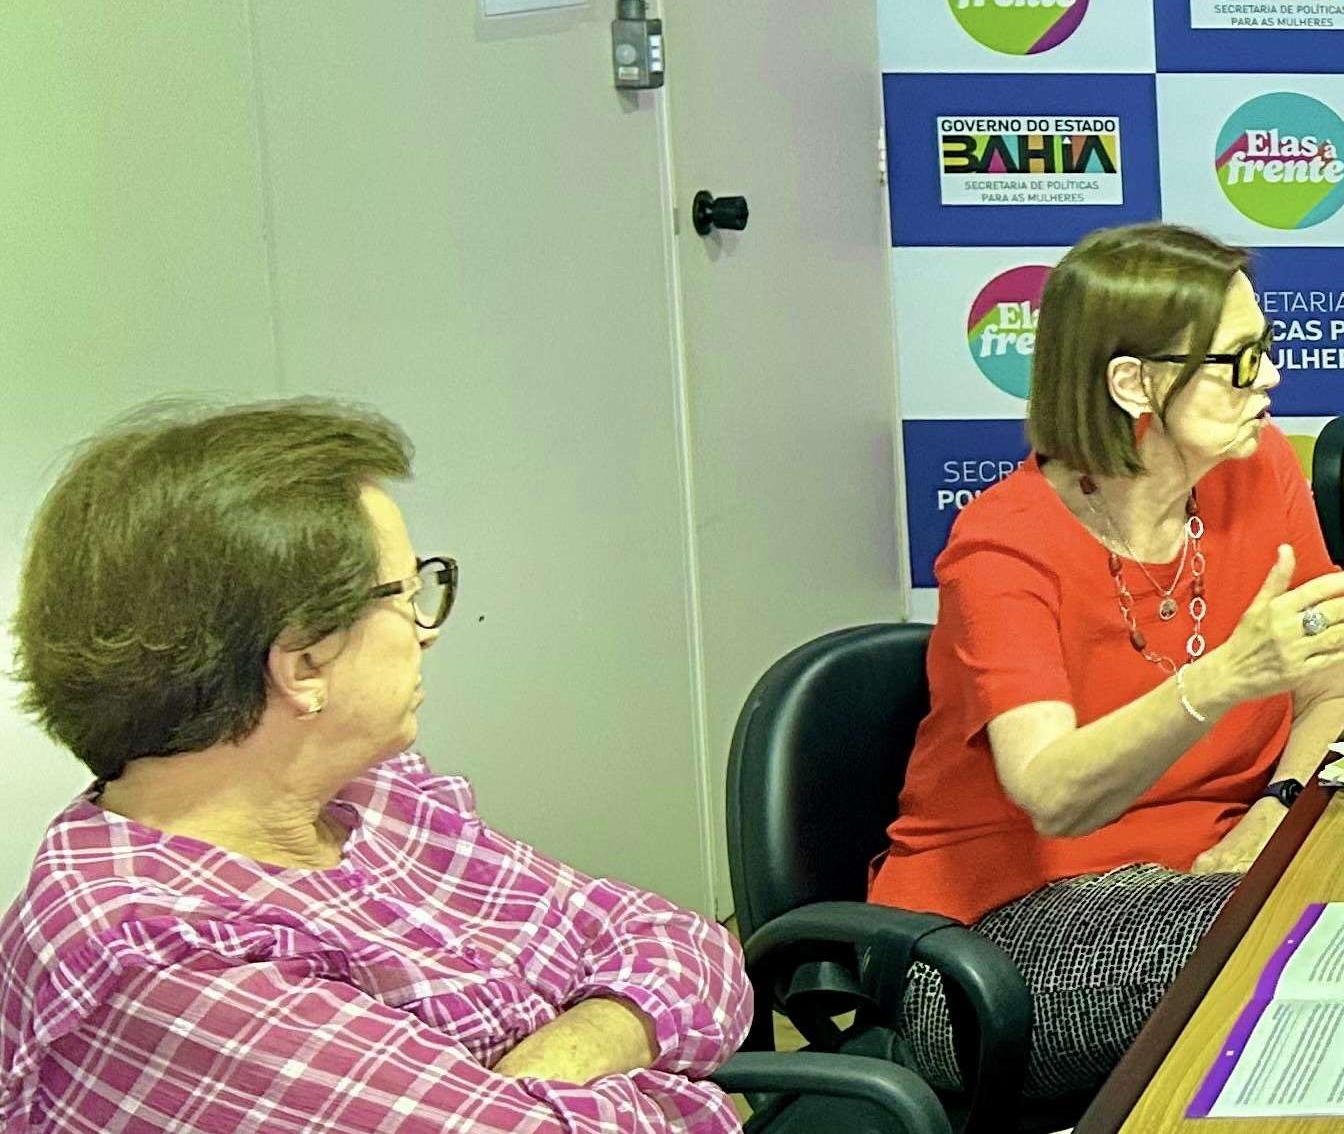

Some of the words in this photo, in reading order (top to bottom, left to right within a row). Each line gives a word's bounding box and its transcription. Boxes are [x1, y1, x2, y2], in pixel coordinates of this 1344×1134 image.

[941, 119, 1021, 133] GOVERNO
[1027, 119, 1049, 132] DO
[1055, 119, 1115, 132] ESTADO
[965, 181, 1027, 191] SECRETARIA
[1031, 181, 1043, 190] DE
[981, 194, 1008, 202] PARA
[1011, 194, 1025, 202] AS
[1028, 194, 1083, 203] MULHERES
[980, 324, 1036, 358] fre
